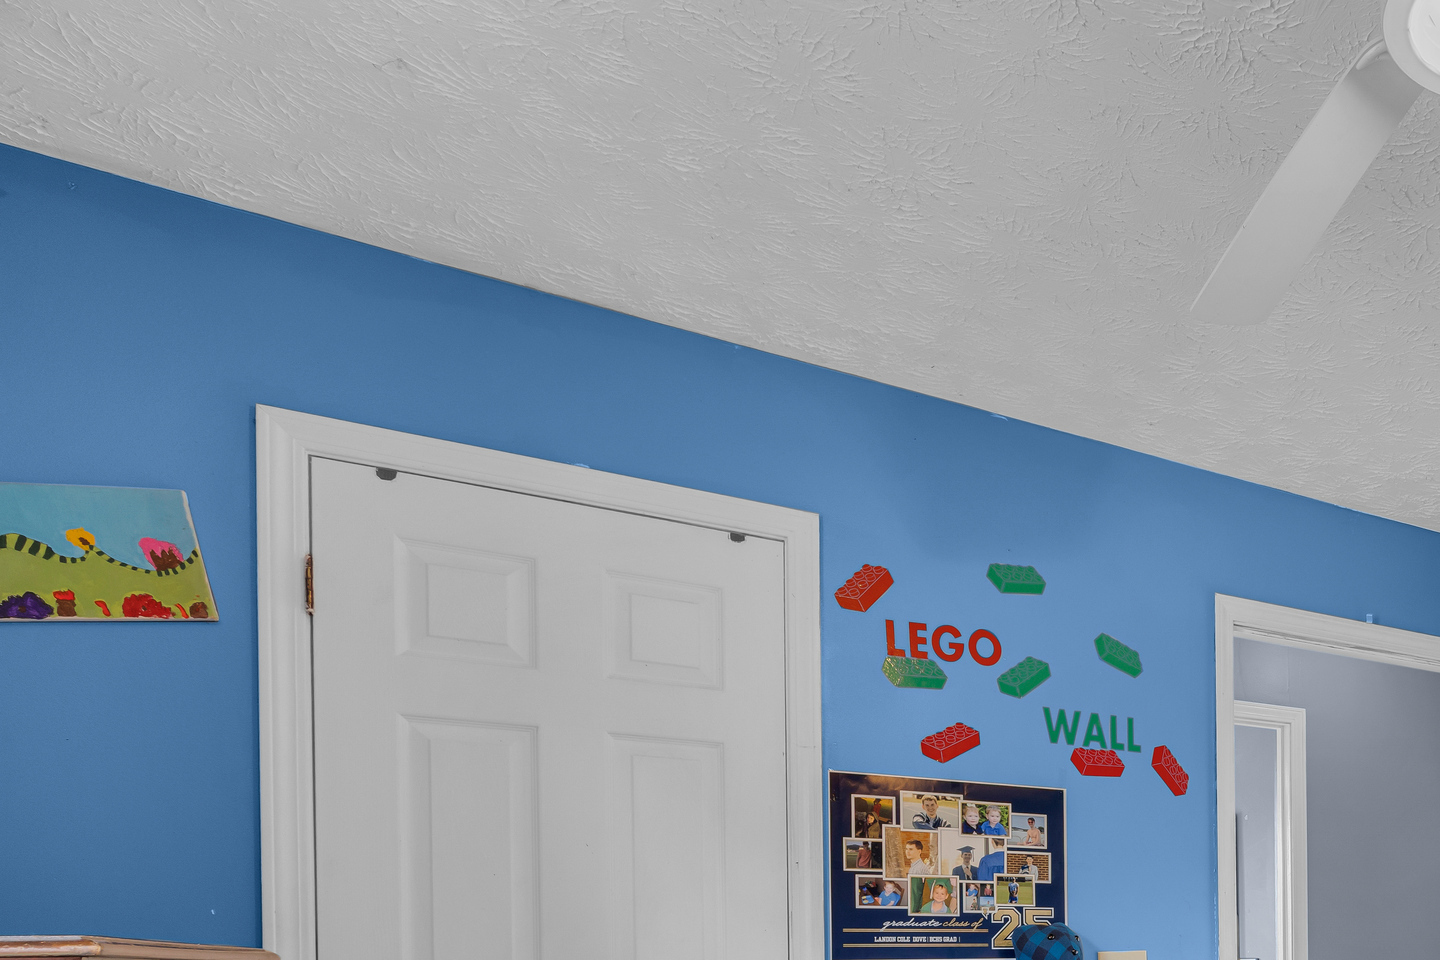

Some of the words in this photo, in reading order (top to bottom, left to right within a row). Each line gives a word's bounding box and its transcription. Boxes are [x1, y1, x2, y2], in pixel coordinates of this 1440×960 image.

[885, 619, 1002, 666] LEGO
[1042, 706, 1142, 753] WALL
[880, 918, 943, 932] graduate
[943, 919, 970, 927] class
[971, 917, 983, 932] of
